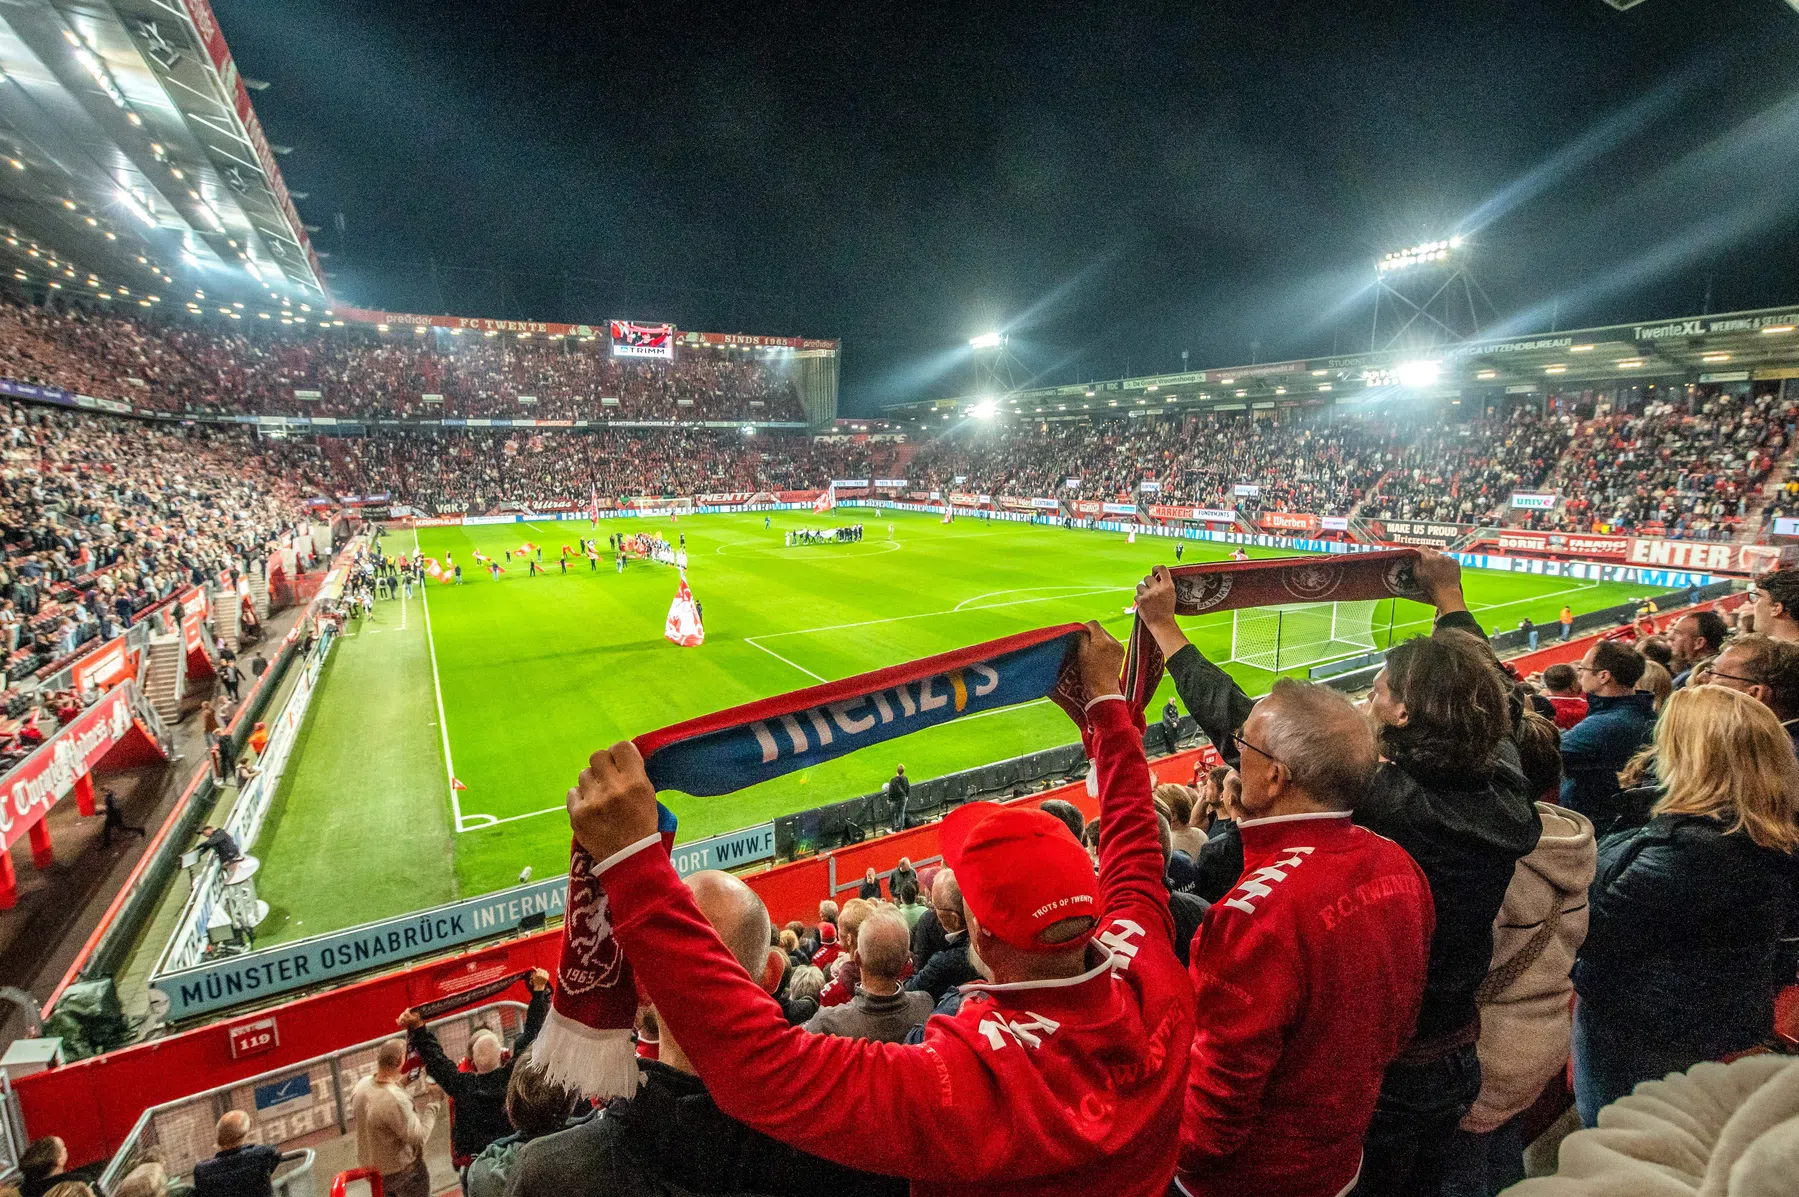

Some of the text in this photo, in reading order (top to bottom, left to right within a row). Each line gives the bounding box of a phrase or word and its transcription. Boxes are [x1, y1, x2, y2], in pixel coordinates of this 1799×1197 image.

[459, 317, 547, 333] FC TWENTE
[724, 335, 788, 346] SINDS 1965
[630, 347, 665, 355] TRIMM
[1273, 515, 1306, 528] Wierden
[1386, 523, 1458, 537] MAKE US PROUD
[1500, 538, 1546, 550] BORNE
[1632, 540, 1731, 569] ENTER
[1032, 894, 1094, 919] TROTS OP TWENTE
[181, 955, 310, 1007] MÜNSTER
[320, 914, 465, 970] OSNABRÜCK
[473, 885, 568, 930] INTERNAT
[716, 832, 773, 862] WWW.F
[566, 967, 596, 985] 1965
[240, 1033, 271, 1051] 119
